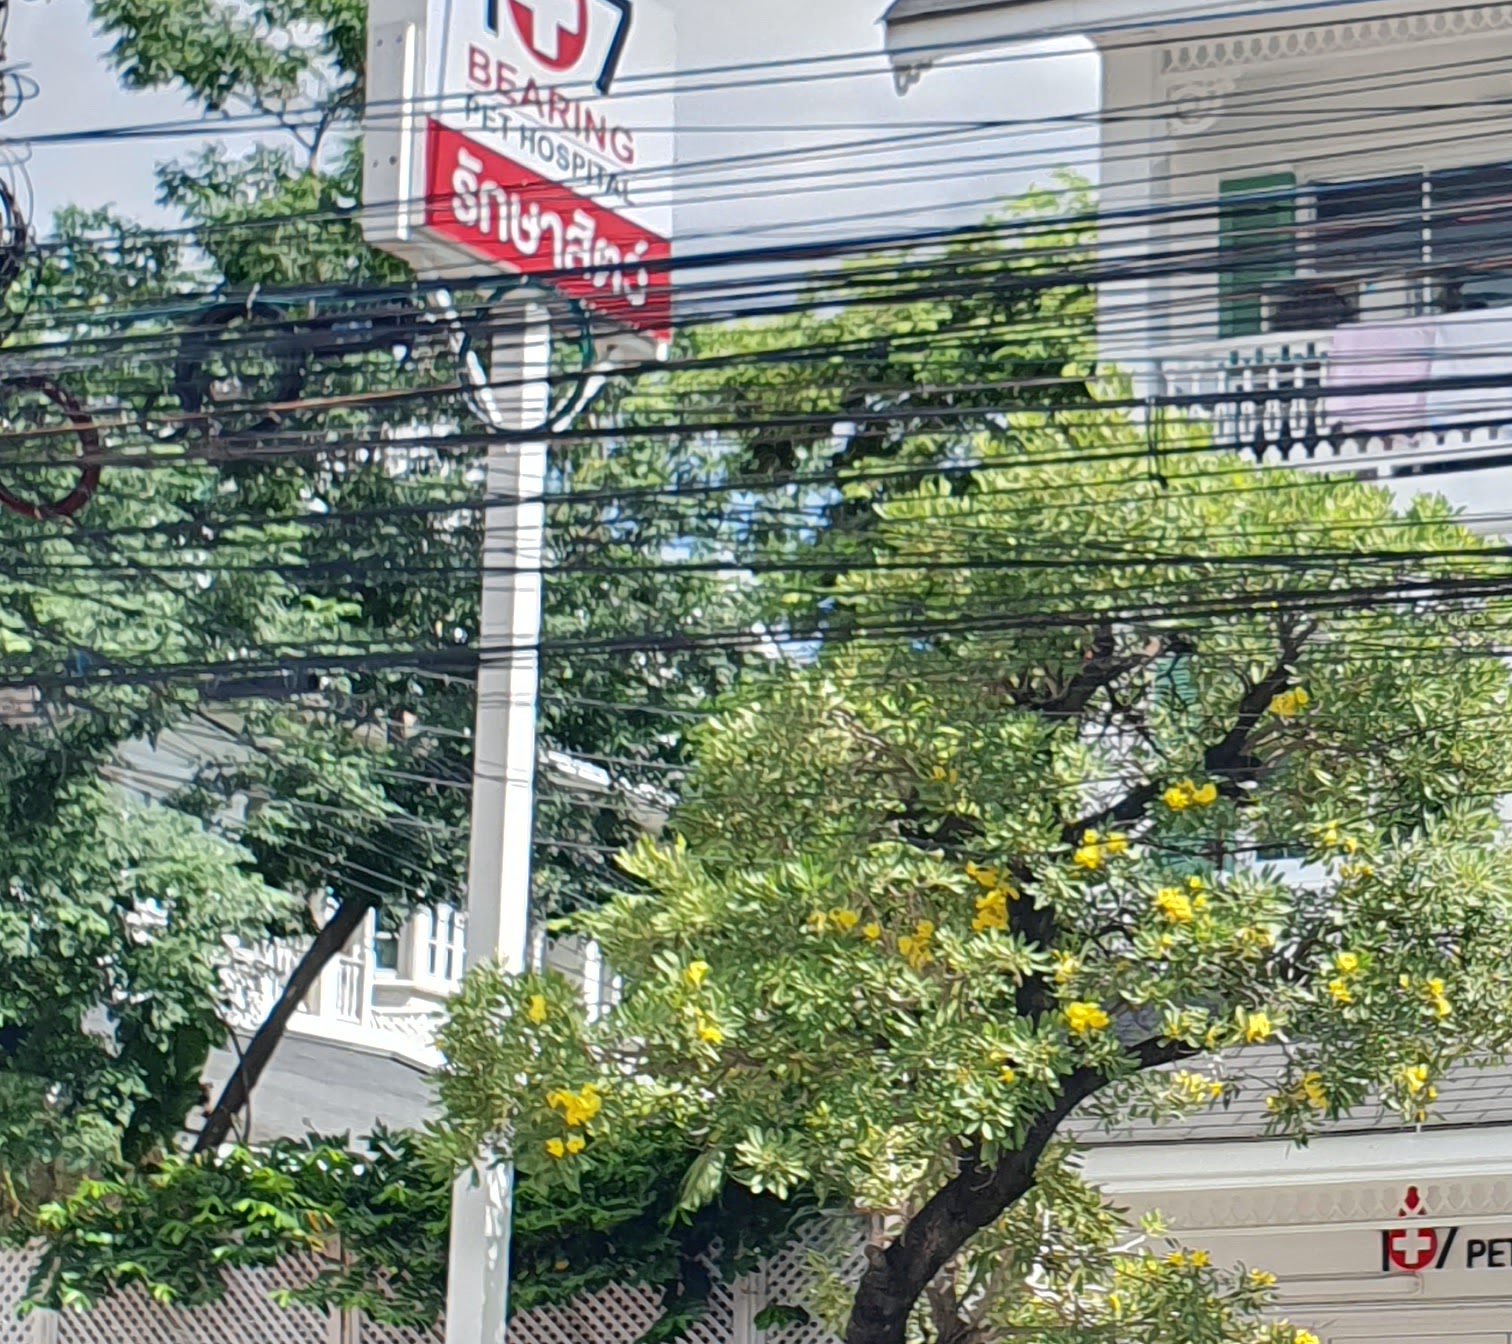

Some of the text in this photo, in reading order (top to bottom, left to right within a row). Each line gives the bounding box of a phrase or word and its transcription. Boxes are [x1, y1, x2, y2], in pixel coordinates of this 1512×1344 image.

[465, 93, 636, 207] PET HOSPITAL
[468, 42, 635, 165] BEARING
